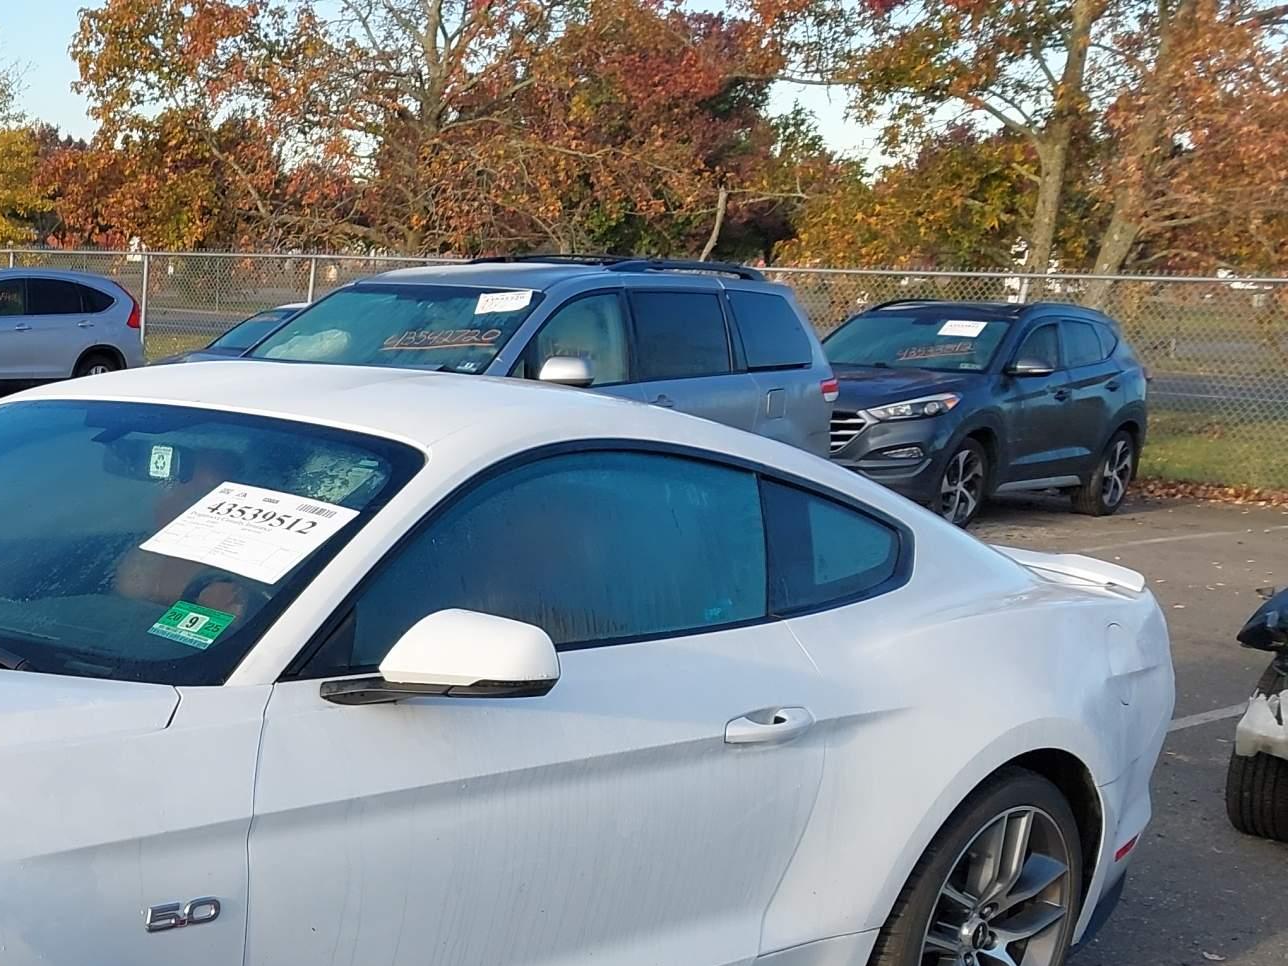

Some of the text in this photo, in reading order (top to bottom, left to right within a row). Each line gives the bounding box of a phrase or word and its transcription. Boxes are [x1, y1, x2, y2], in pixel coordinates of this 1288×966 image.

[207, 500, 318, 535] 43539512
[167, 611, 182, 622] 20
[185, 616, 200, 629] 9
[204, 622, 221, 633] 25
